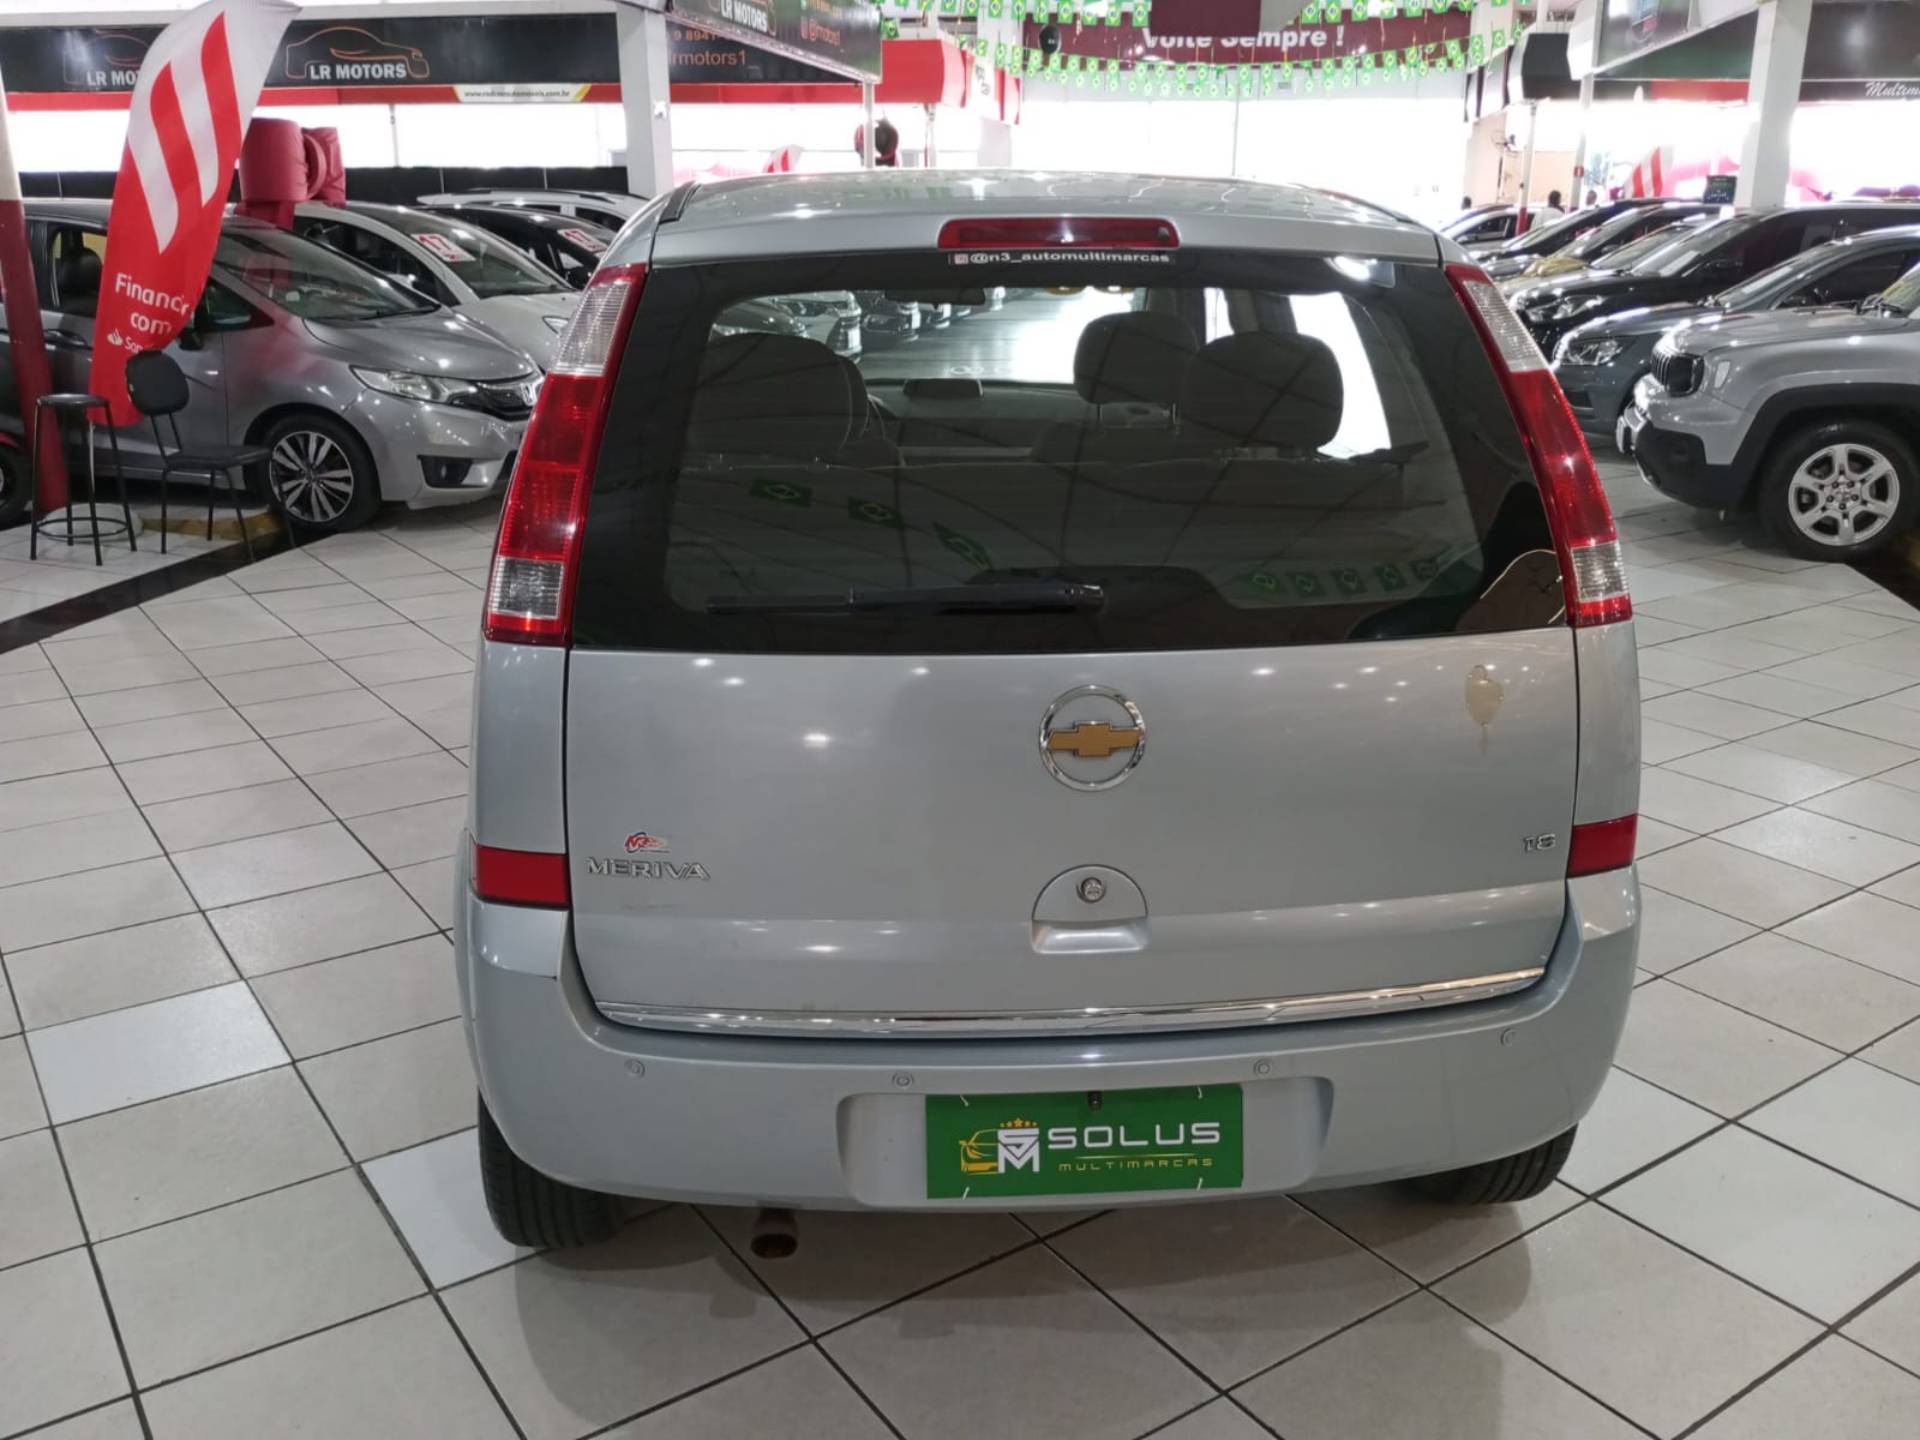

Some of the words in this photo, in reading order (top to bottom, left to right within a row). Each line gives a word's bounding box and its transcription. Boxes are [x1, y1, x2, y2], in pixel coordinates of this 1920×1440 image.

[733, 0, 769, 33] MOTORS
[86, 71, 107, 87] LR
[111, 70, 141, 87] MO
[310, 64, 331, 80] LR
[336, 63, 407, 79] MOTORS
[970, 251, 1171, 264] @n3_automultimarcas
[130, 312, 172, 335] com
[586, 856, 711, 881] MERIVA
[1048, 1121, 1221, 1150] SOLUS
[1058, 1157, 1214, 1172] MULTIMARCAS
